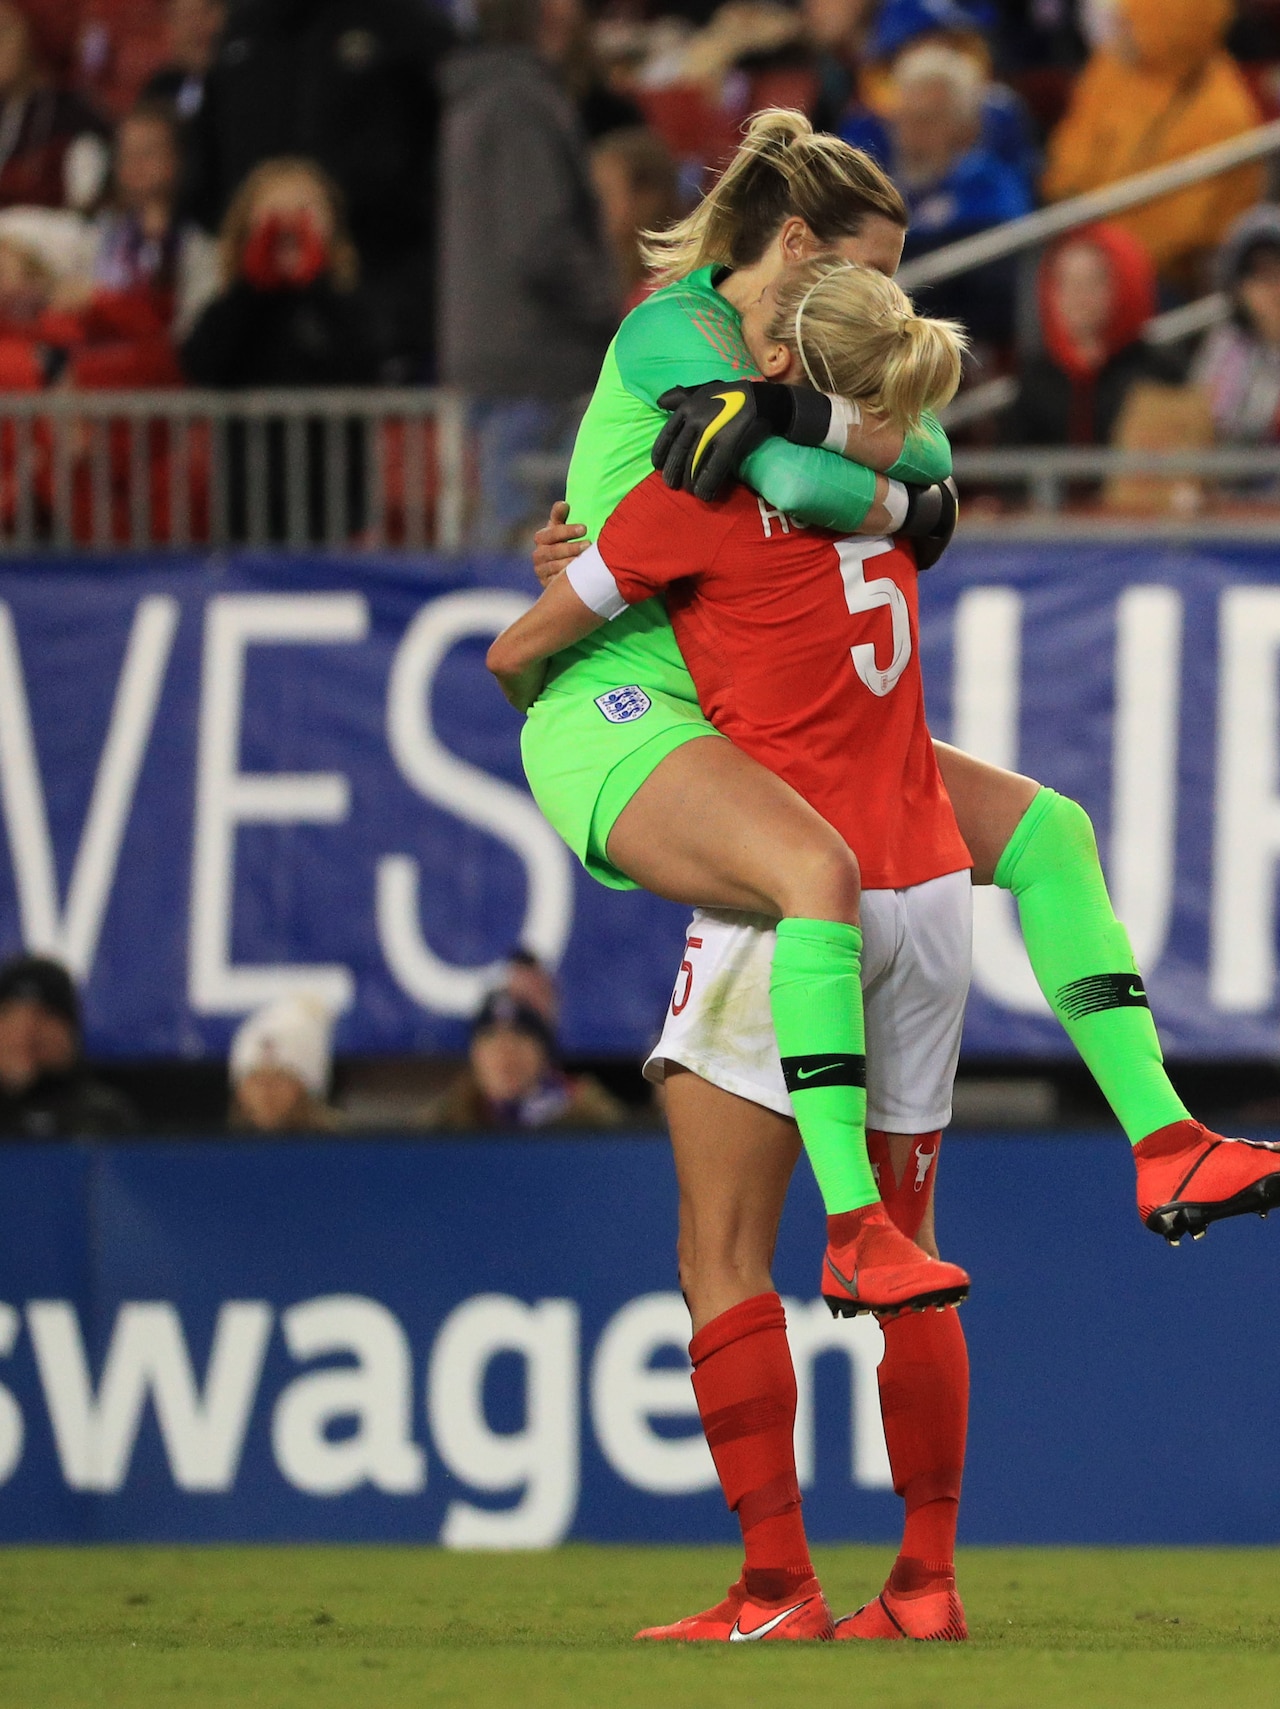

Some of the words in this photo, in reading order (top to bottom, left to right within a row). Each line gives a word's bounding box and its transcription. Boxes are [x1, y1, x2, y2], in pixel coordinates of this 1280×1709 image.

[833, 534, 912, 697] 5
[671, 936, 703, 1017] 5
[0, 1290, 896, 1550] wagen
